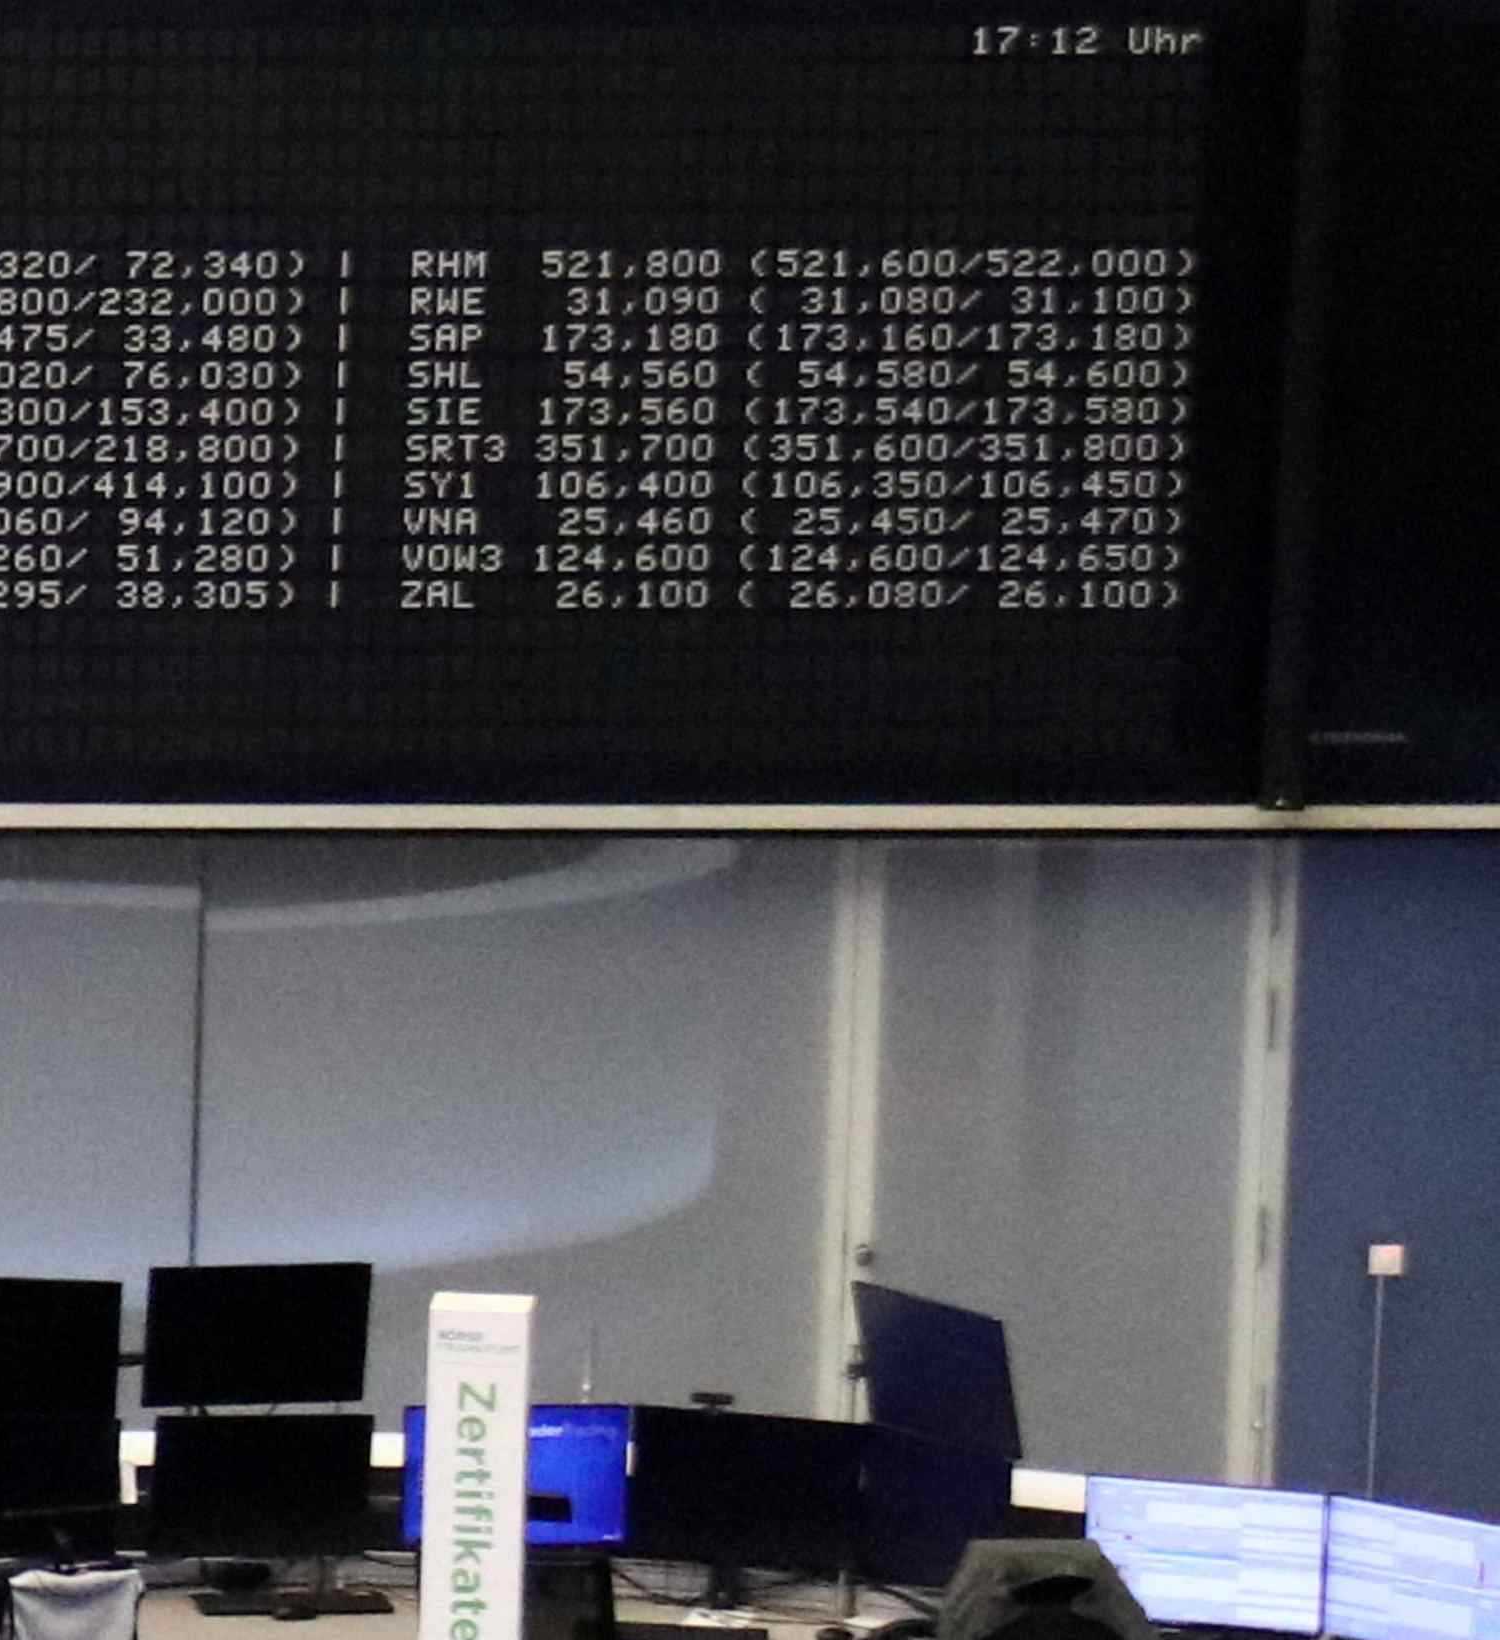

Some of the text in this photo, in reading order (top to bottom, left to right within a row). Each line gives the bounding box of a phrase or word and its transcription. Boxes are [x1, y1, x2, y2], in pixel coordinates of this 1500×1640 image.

[972, 24, 1203, 56] 17:12 Uhr
[410, 248, 489, 279] RHM
[540, 248, 721, 280] 521,800
[409, 284, 720, 317] RWE 31,090
[407, 322, 484, 353] SAP
[542, 321, 719, 354] 173,180
[407, 358, 718, 390] SHL 54,560
[405, 396, 482, 427] SIE
[539, 395, 716, 427] 173,560
[405, 432, 507, 464] SRT3
[534, 432, 715, 464] 351,700
[402, 469, 475, 500] SY1
[536, 469, 713, 500] 106,400
[402, 505, 712, 537] VNA 25,460
[401, 542, 504, 573] VOW3
[534, 542, 710, 573] 124,600
[399, 578, 710, 610] ZAL 26,100
